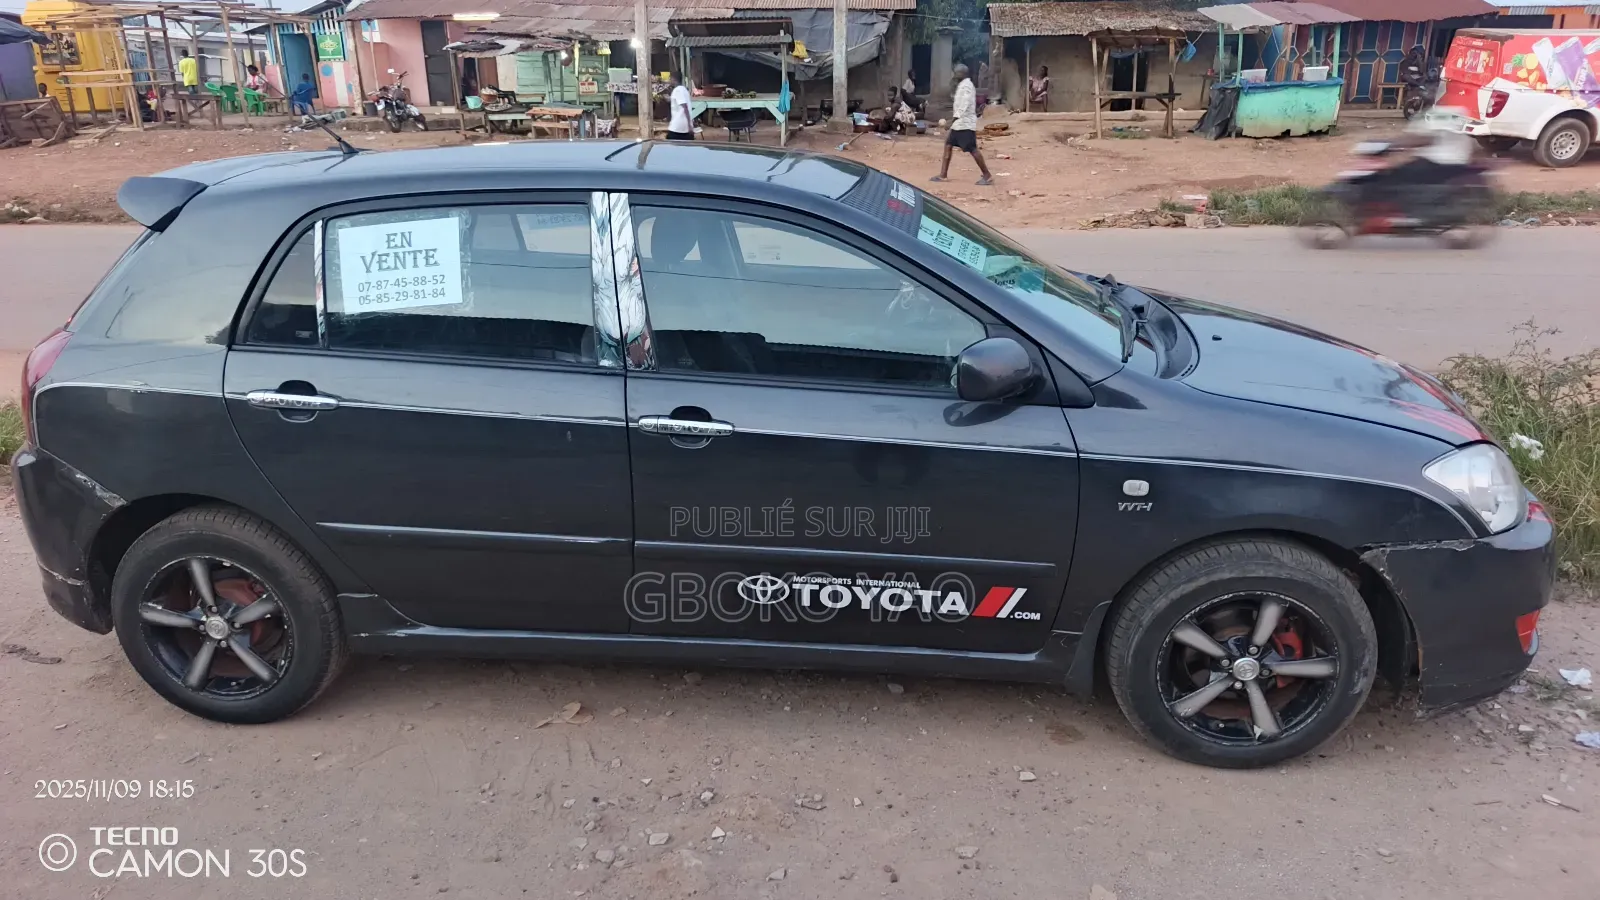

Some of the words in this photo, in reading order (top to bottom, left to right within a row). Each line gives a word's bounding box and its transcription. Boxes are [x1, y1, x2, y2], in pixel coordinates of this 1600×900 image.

[385, 231, 413, 249] EN
[360, 248, 441, 274] VENTE
[358, 274, 446, 293] 07-87-45-88-52
[358, 287, 446, 305] 05-85-29-81-84
[793, 575, 852, 586] MOTORSPORTS
[856, 578, 921, 589] INTERNATIONAL
[792, 583, 970, 616] TOYOTA
[1010, 611, 1041, 620] .COM
